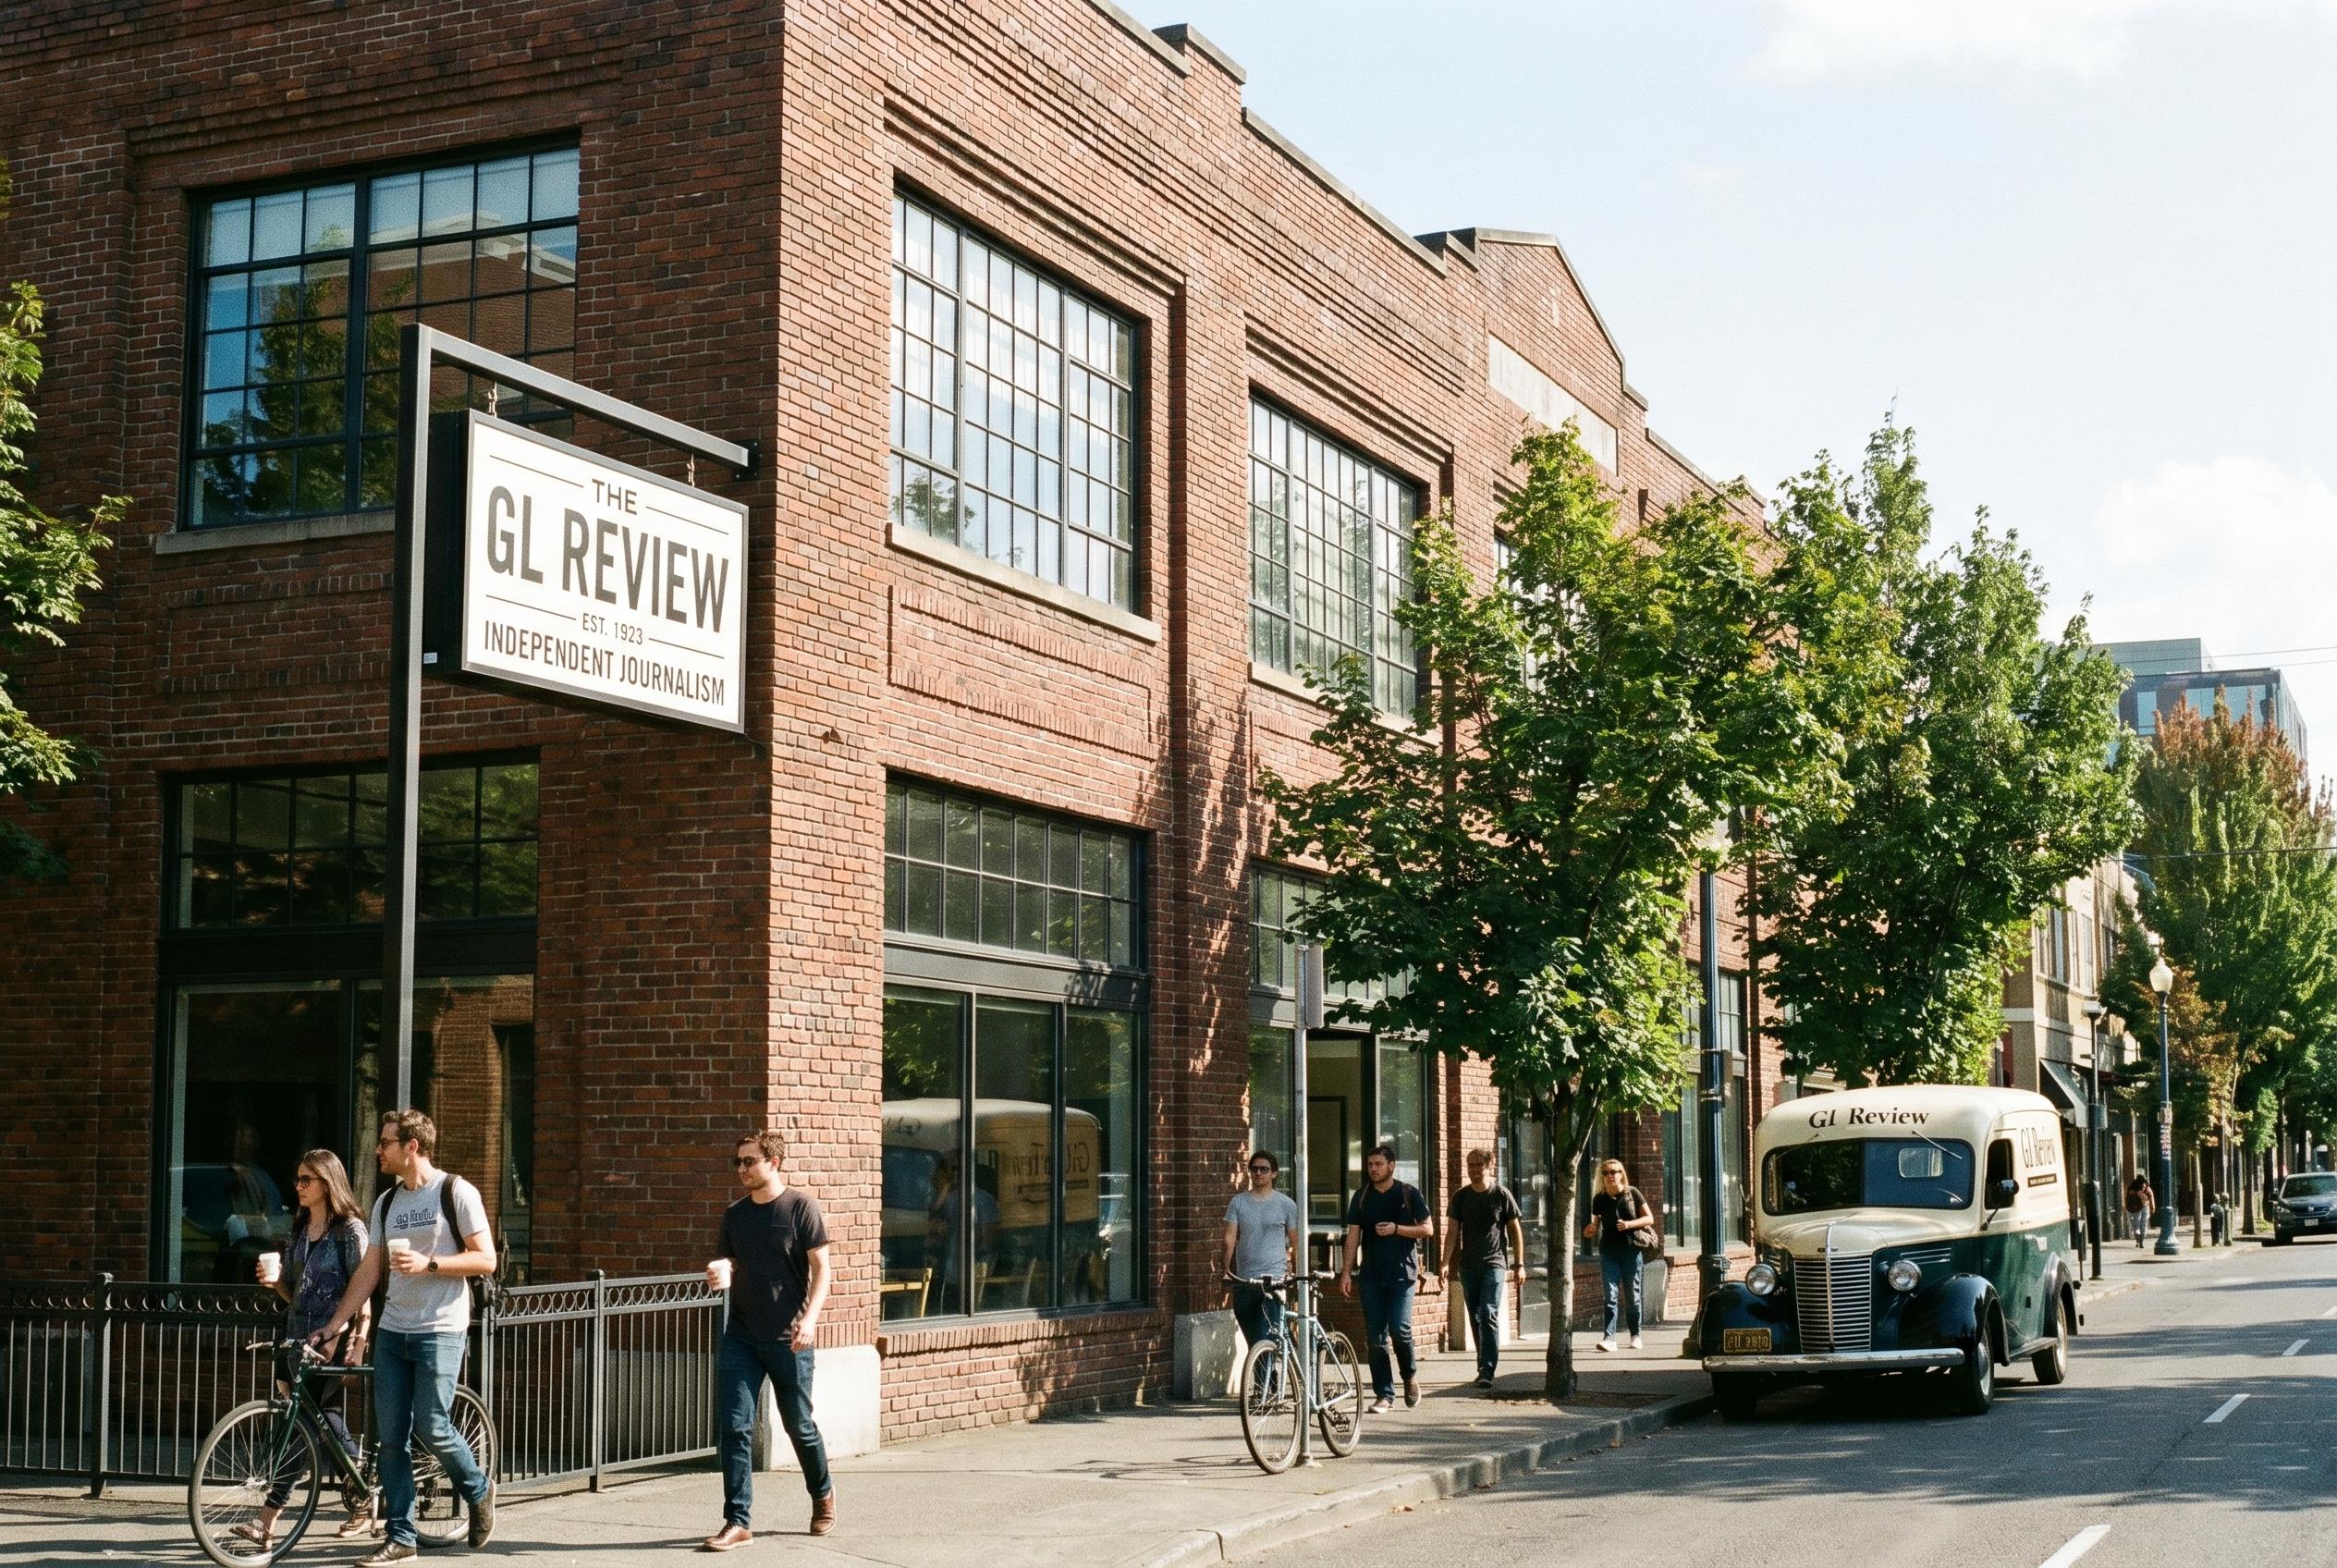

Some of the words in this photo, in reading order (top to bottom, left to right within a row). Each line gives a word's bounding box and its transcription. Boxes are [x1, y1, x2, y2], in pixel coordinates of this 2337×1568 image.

[592, 479, 638, 515] THE
[487, 486, 544, 584] GL
[562, 508, 729, 633] REVIEW
[582, 613, 607, 636] EST.
[614, 622, 643, 645] 1923
[484, 620, 615, 680] INDEPENDENT
[619, 655, 725, 706] JOURNALISM
[1847, 1107, 1930, 1125] Review
